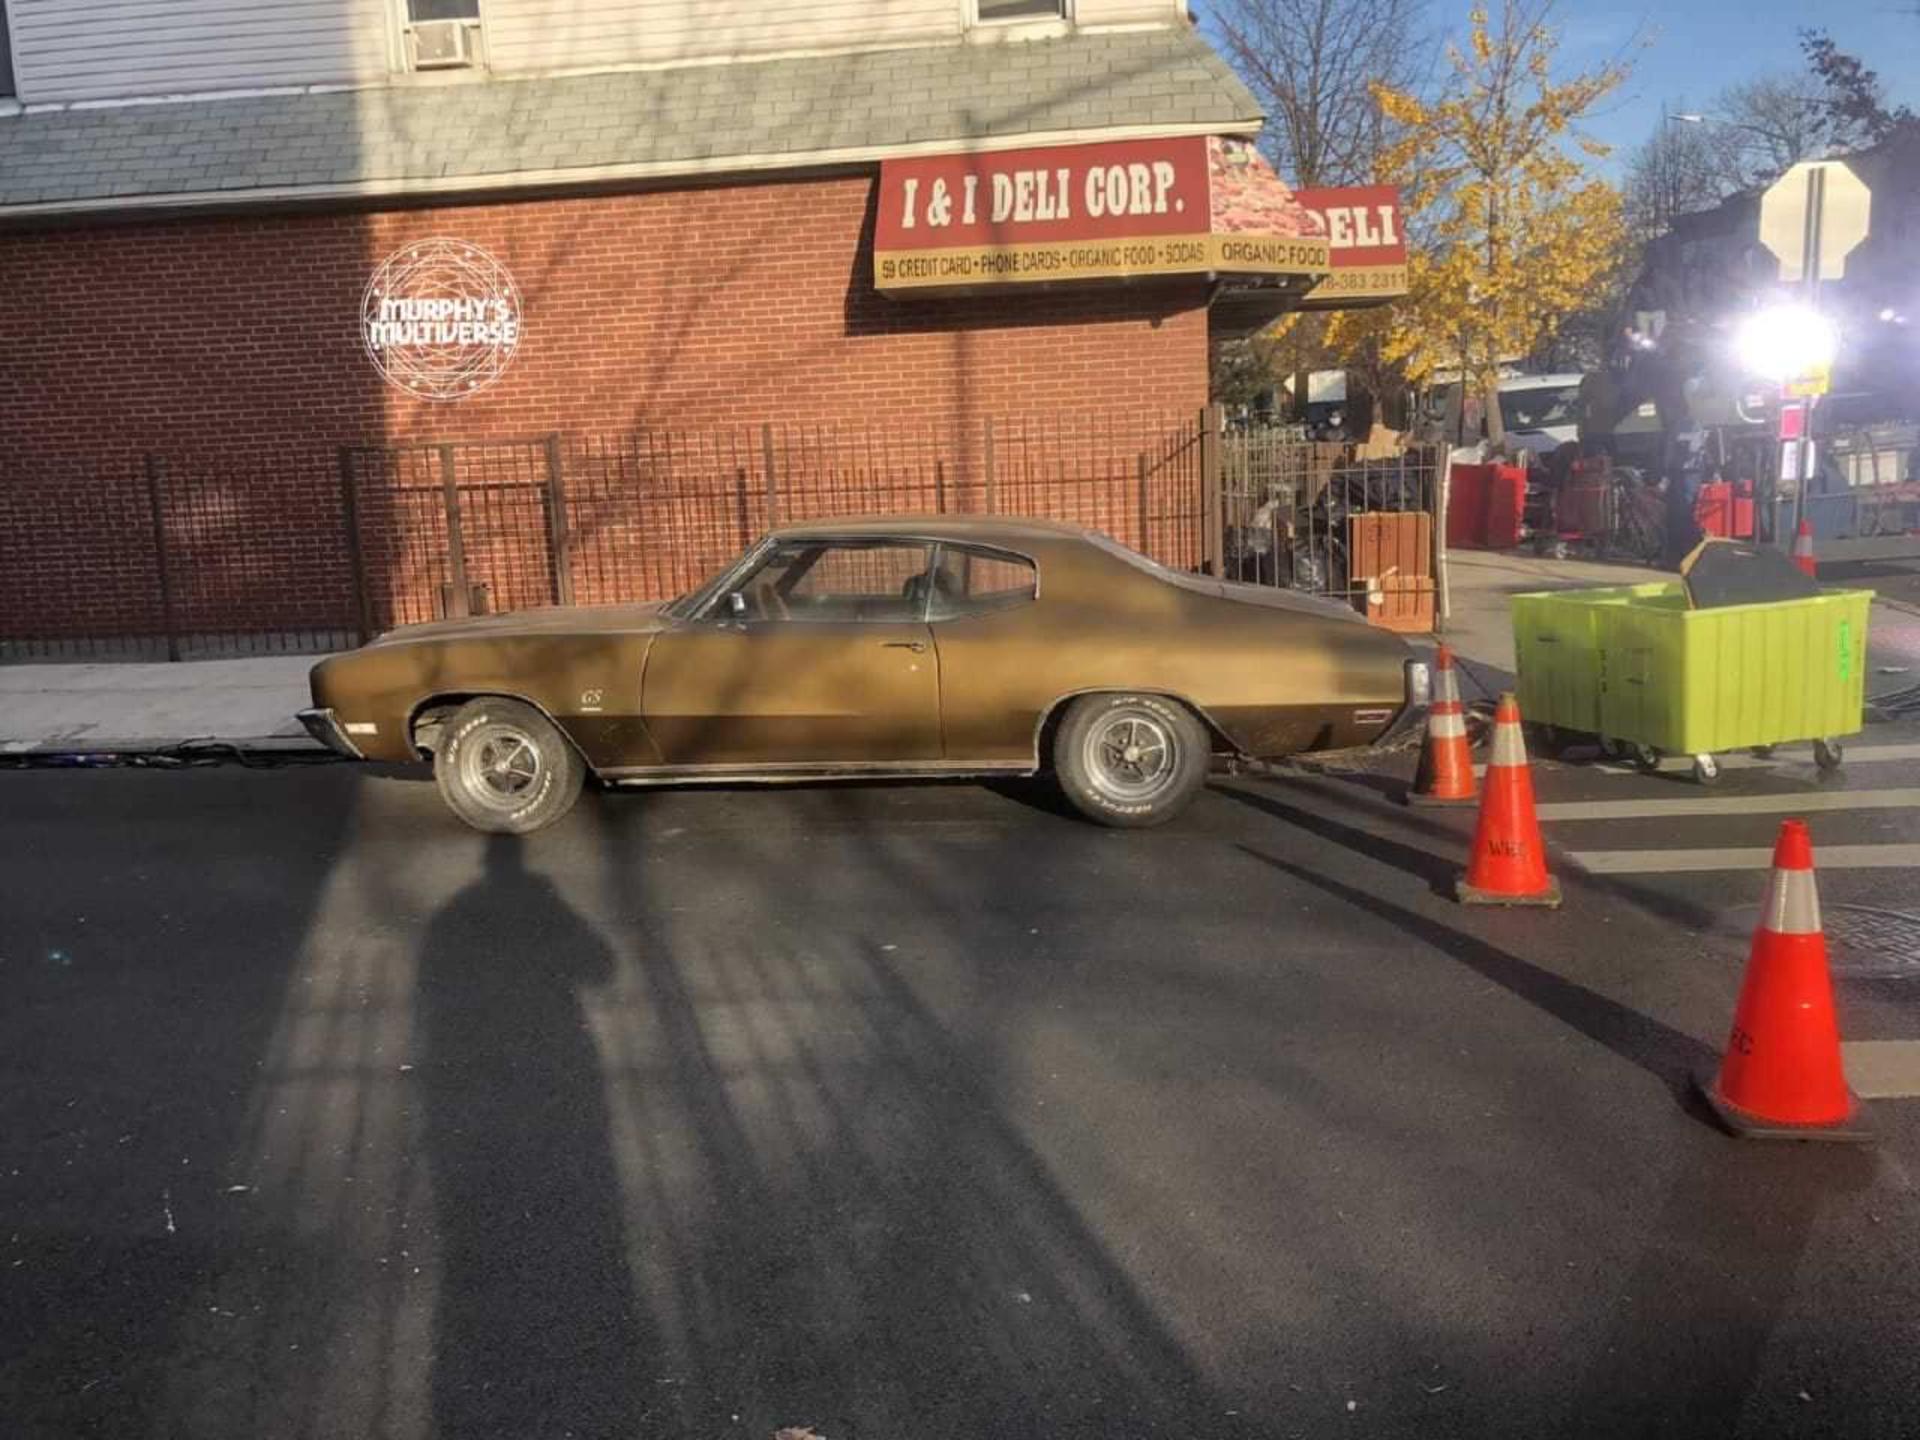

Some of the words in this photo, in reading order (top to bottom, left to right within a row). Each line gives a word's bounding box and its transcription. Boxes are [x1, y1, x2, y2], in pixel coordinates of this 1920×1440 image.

[901, 178, 918, 229] I
[927, 177, 952, 227] &
[962, 174, 977, 225] I
[991, 168, 1070, 223] DELI
[1085, 160, 1184, 217] CORP.
[898, 256, 939, 279] CREDIT
[940, 255, 972, 276] CARD
[980, 251, 1020, 273] PHONE
[1022, 249, 1061, 273] CARDS
[1069, 246, 1121, 269] ORGANIC
[1123, 244, 1155, 266] FOOD
[1165, 242, 1205, 264] SODAS
[1221, 242, 1286, 264] ORGANIC
[1289, 247, 1325, 266] FOOD
[1371, 271, 1405, 288] 2311
